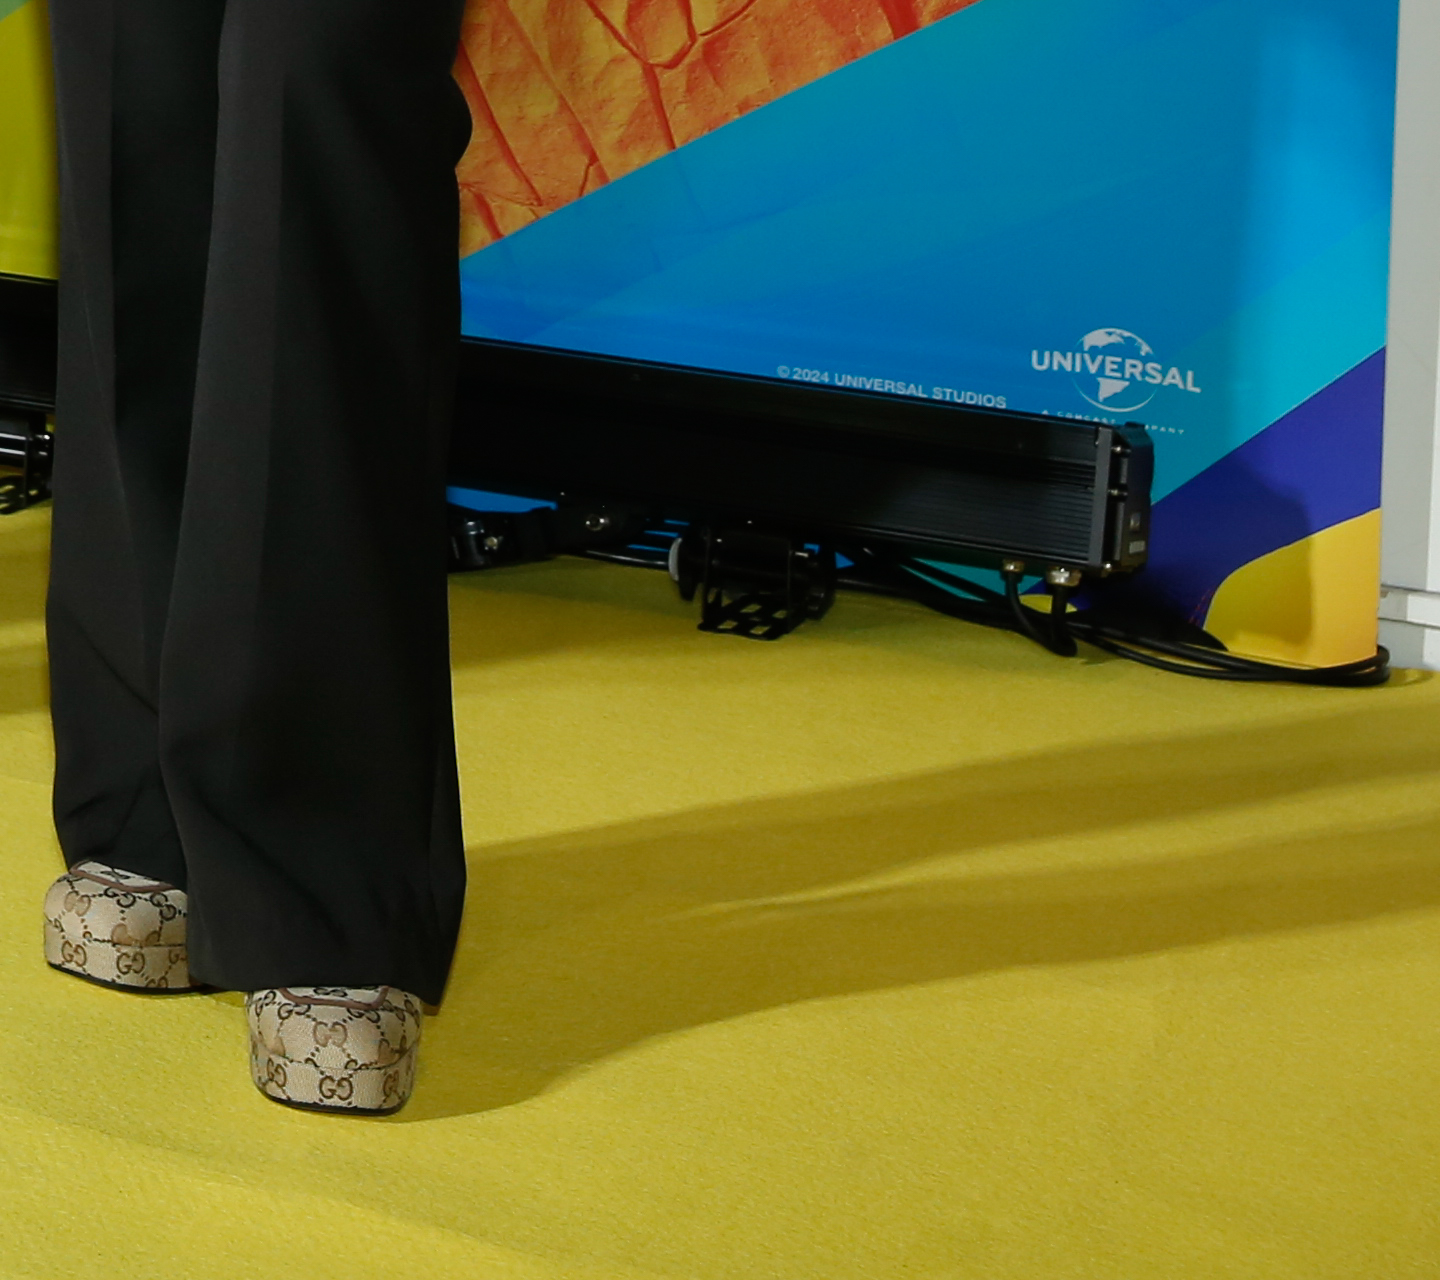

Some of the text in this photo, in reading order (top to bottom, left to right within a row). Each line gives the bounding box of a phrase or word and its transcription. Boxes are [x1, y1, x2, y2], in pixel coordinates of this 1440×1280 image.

[791, 366, 830, 384] 2024
[834, 372, 929, 399] UNIVERSAL
[932, 386, 1008, 410] STUDIOS
[1031, 349, 1203, 394] UNIVERSAL
